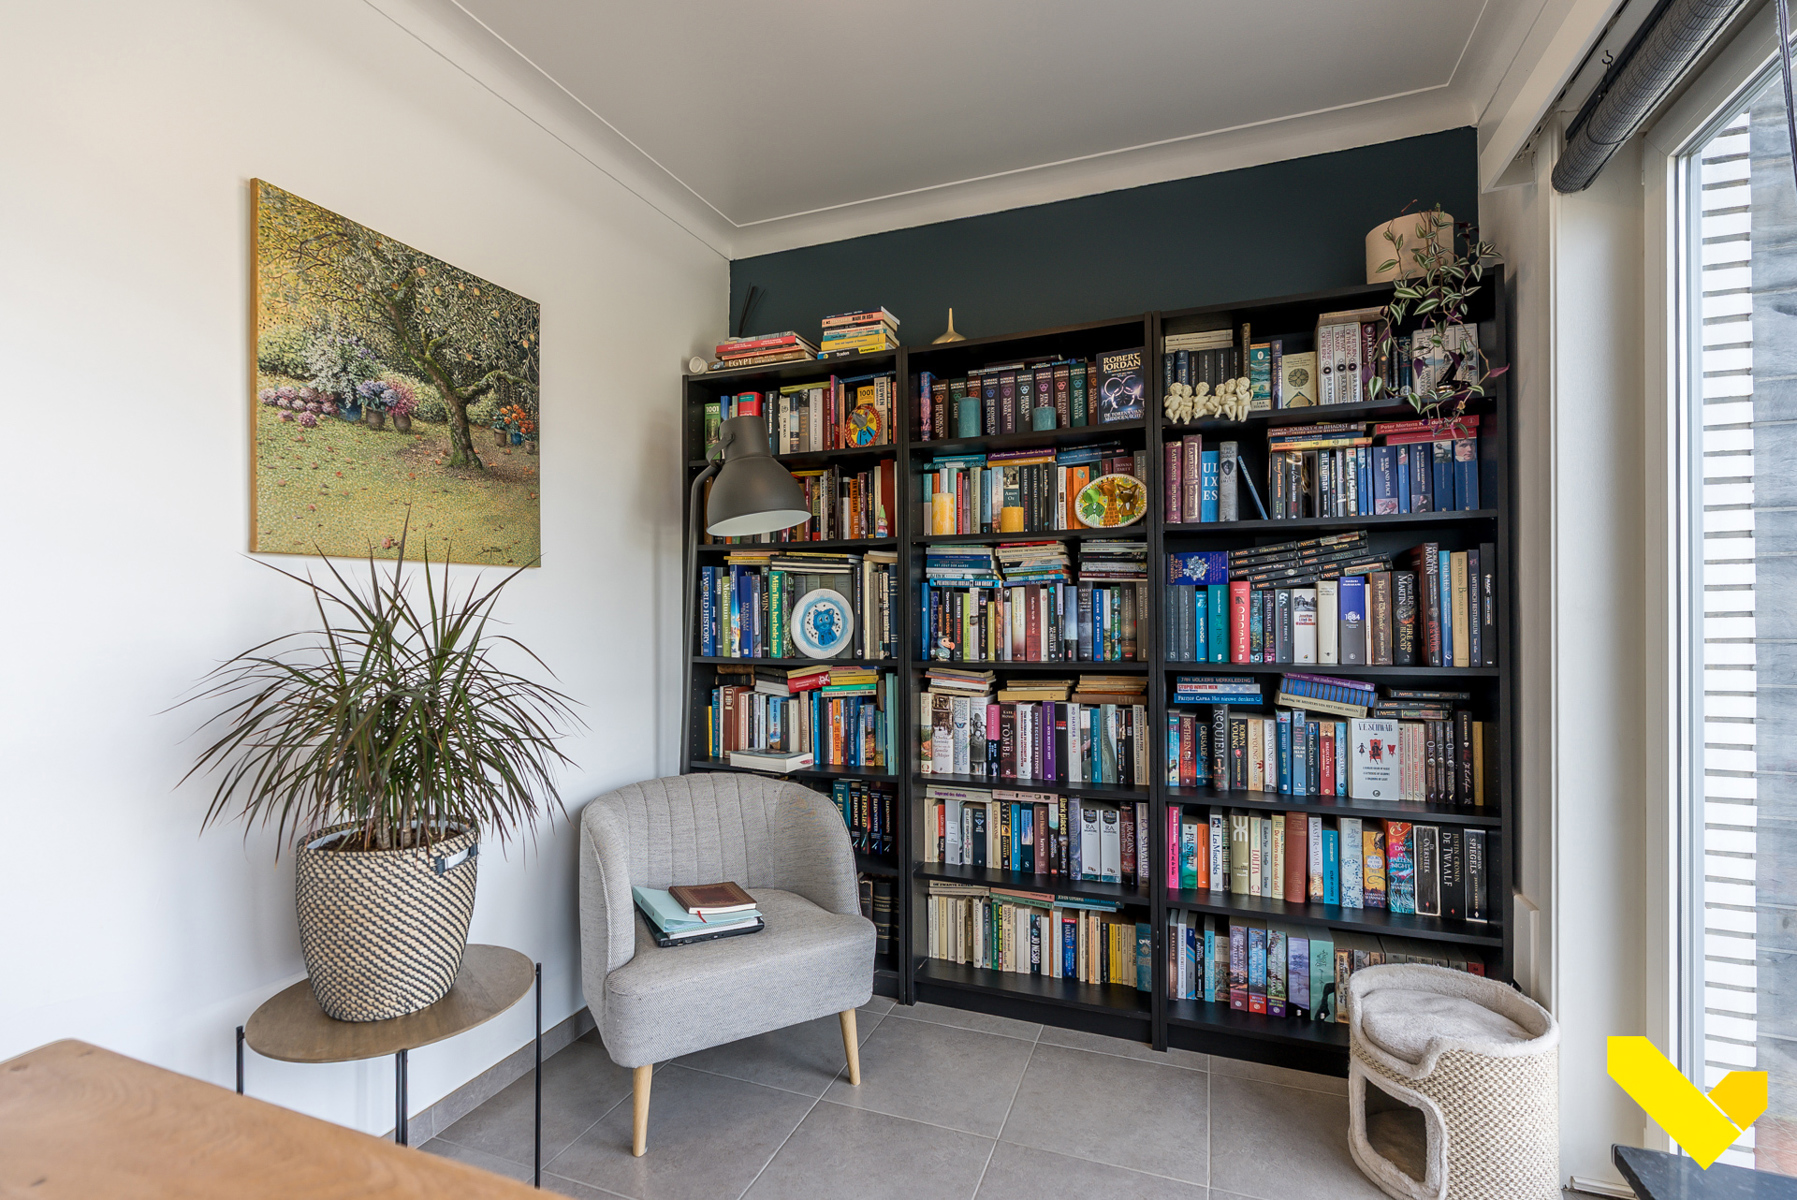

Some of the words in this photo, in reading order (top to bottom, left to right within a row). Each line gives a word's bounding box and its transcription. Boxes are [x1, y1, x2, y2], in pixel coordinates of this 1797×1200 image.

[728, 359, 752, 367] EGYPT
[1103, 353, 1140, 363] ROBERT
[1103, 359, 1141, 372] JORDAN
[1203, 463, 1219, 473] UL
[1204, 476, 1218, 487] IX
[1203, 491, 1218, 500] ES
[771, 575, 779, 592] Mijn
[1398, 576, 1406, 605] MARTIN
[1458, 587, 1466, 615] BESTIARIUM
[771, 639, 779, 654] jaar
[837, 794, 842, 803] DE
[1059, 814, 1067, 835] places
[1443, 833, 1450, 844] DE
[1186, 833, 1194, 867] FALSTAFF
[1141, 836, 1149, 878] SALVATORE
[1391, 862, 1412, 870] NIGHT
[1443, 847, 1452, 886] TWAALF
[1032, 936, 1039, 944] JO
